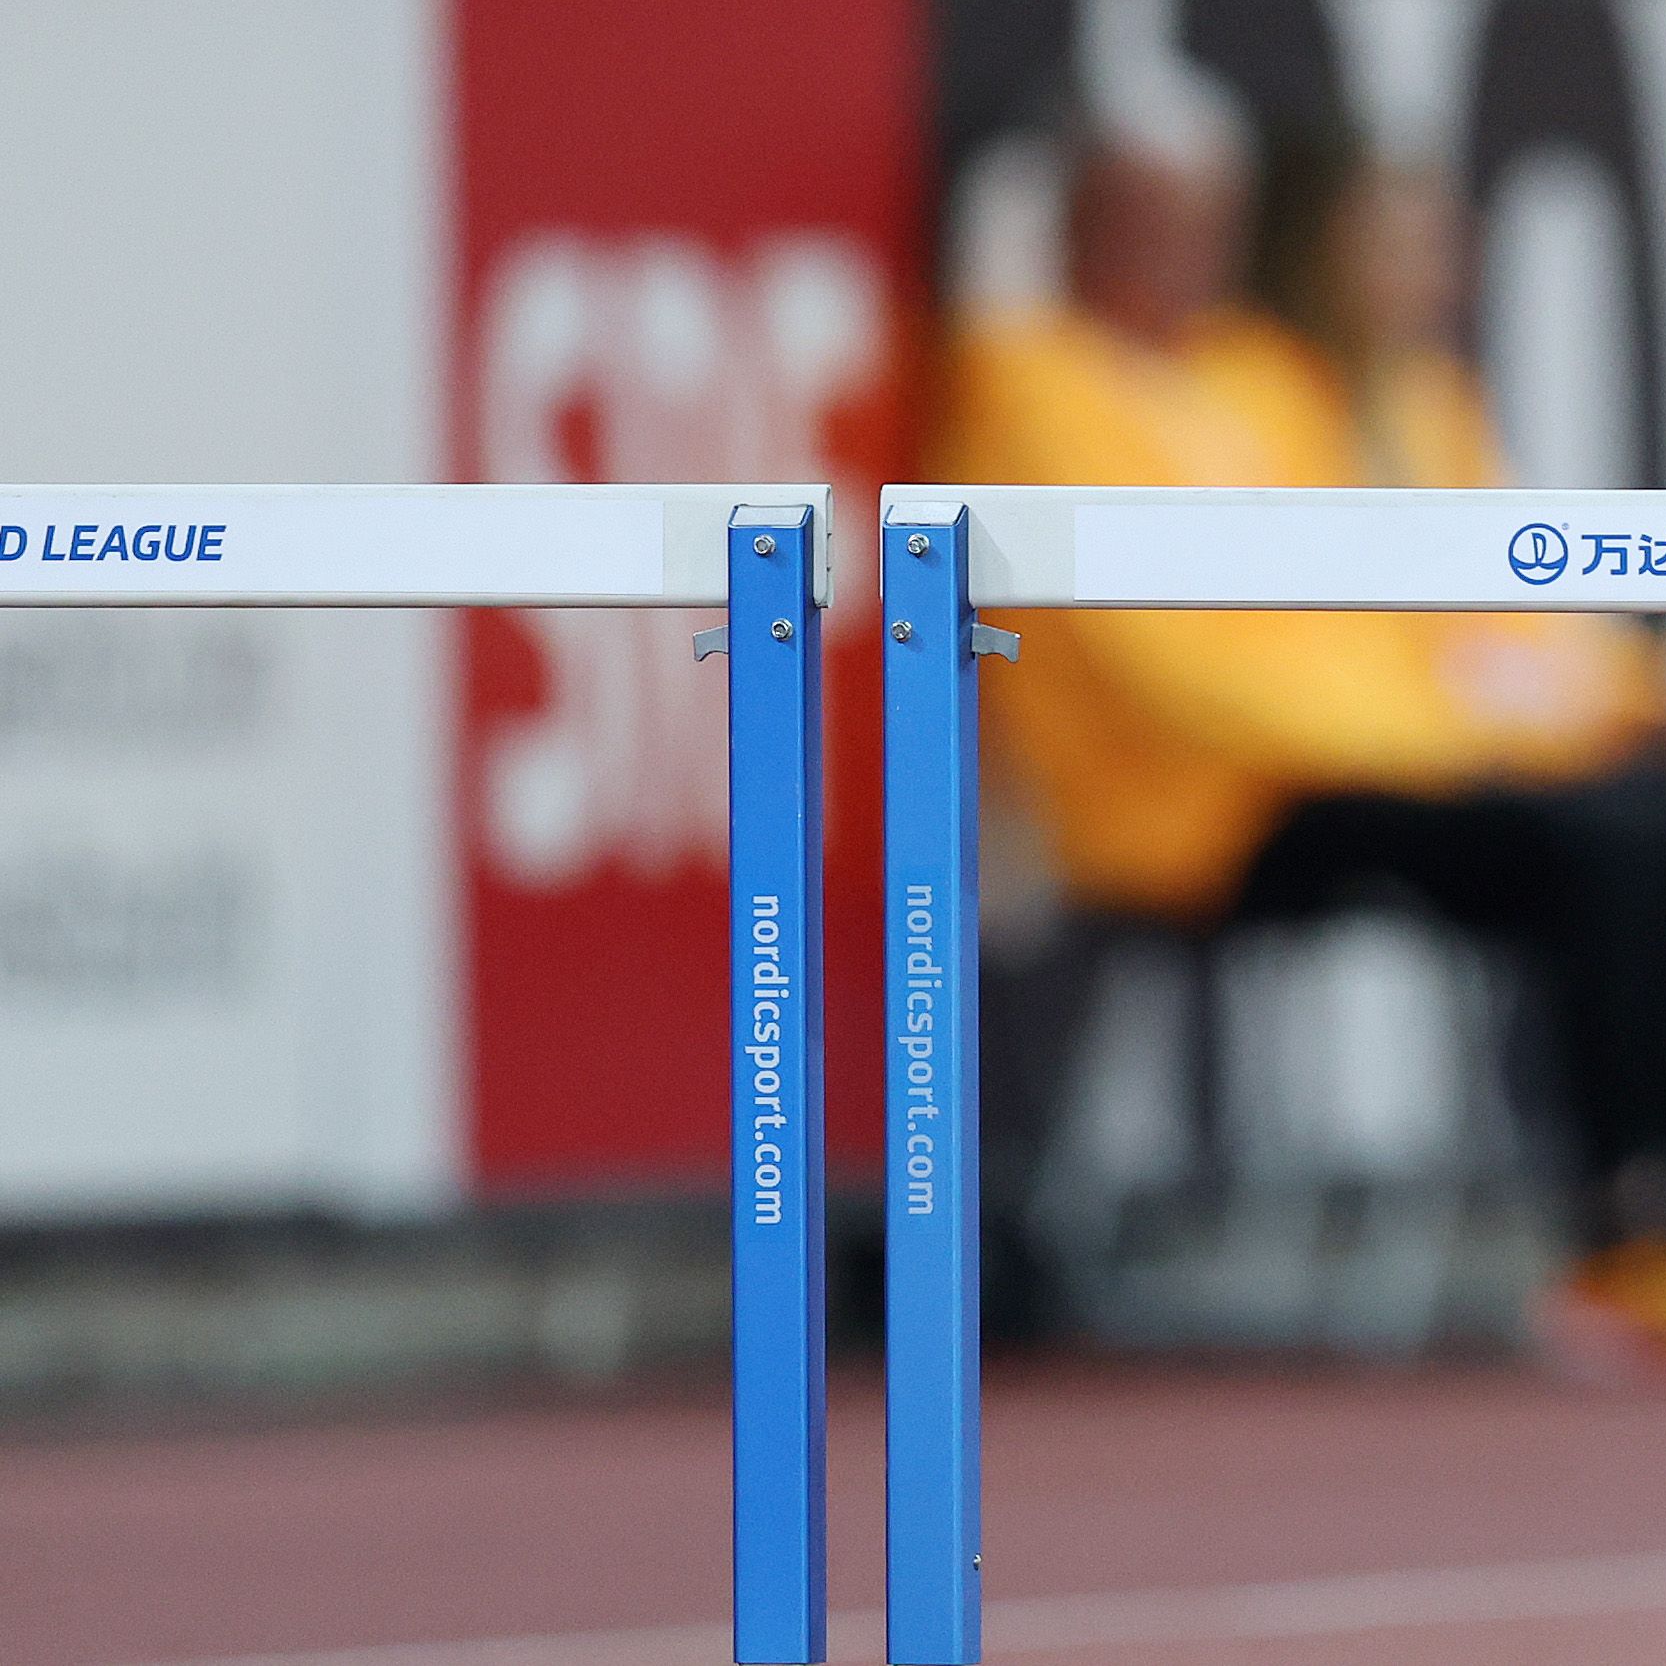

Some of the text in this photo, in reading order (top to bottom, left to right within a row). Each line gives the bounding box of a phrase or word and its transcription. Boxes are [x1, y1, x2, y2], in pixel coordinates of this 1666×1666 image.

[41, 525, 227, 562] LEAGUE
[744, 894, 790, 1225] nordicsport.com
[897, 884, 943, 1215] nordicsport.com
